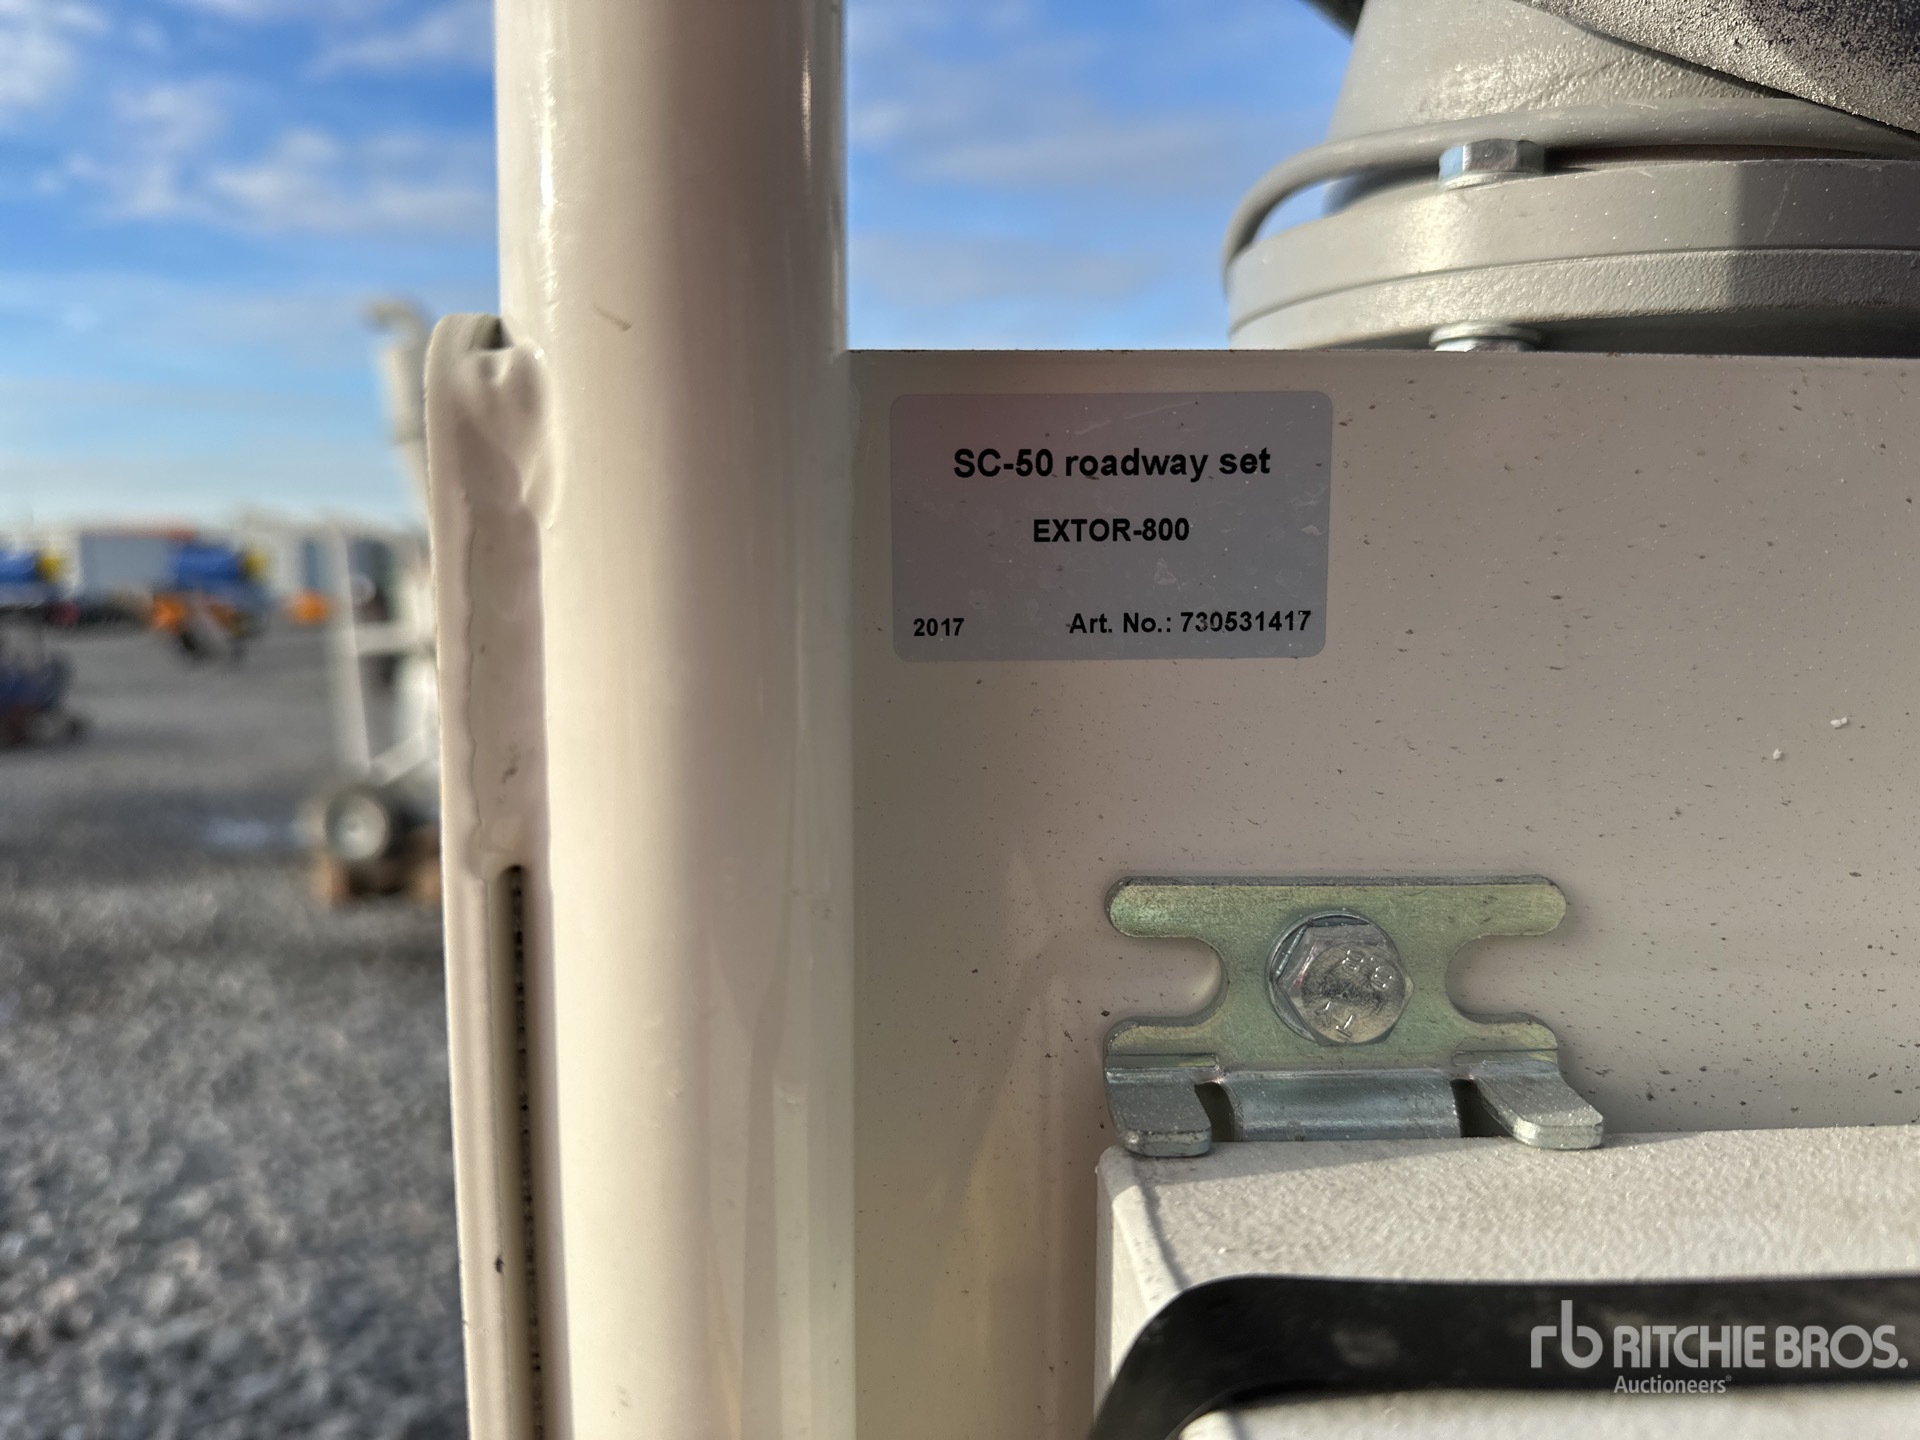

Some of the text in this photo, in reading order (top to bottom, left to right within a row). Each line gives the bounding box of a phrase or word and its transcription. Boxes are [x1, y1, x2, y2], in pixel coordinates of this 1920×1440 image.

[953, 447, 1271, 483] SC-50 roadway set
[1033, 517, 1190, 543] EXTOR-800
[913, 617, 965, 637] 2017
[1069, 612, 1113, 634] Art.
[1180, 609, 1312, 633] 730531417
